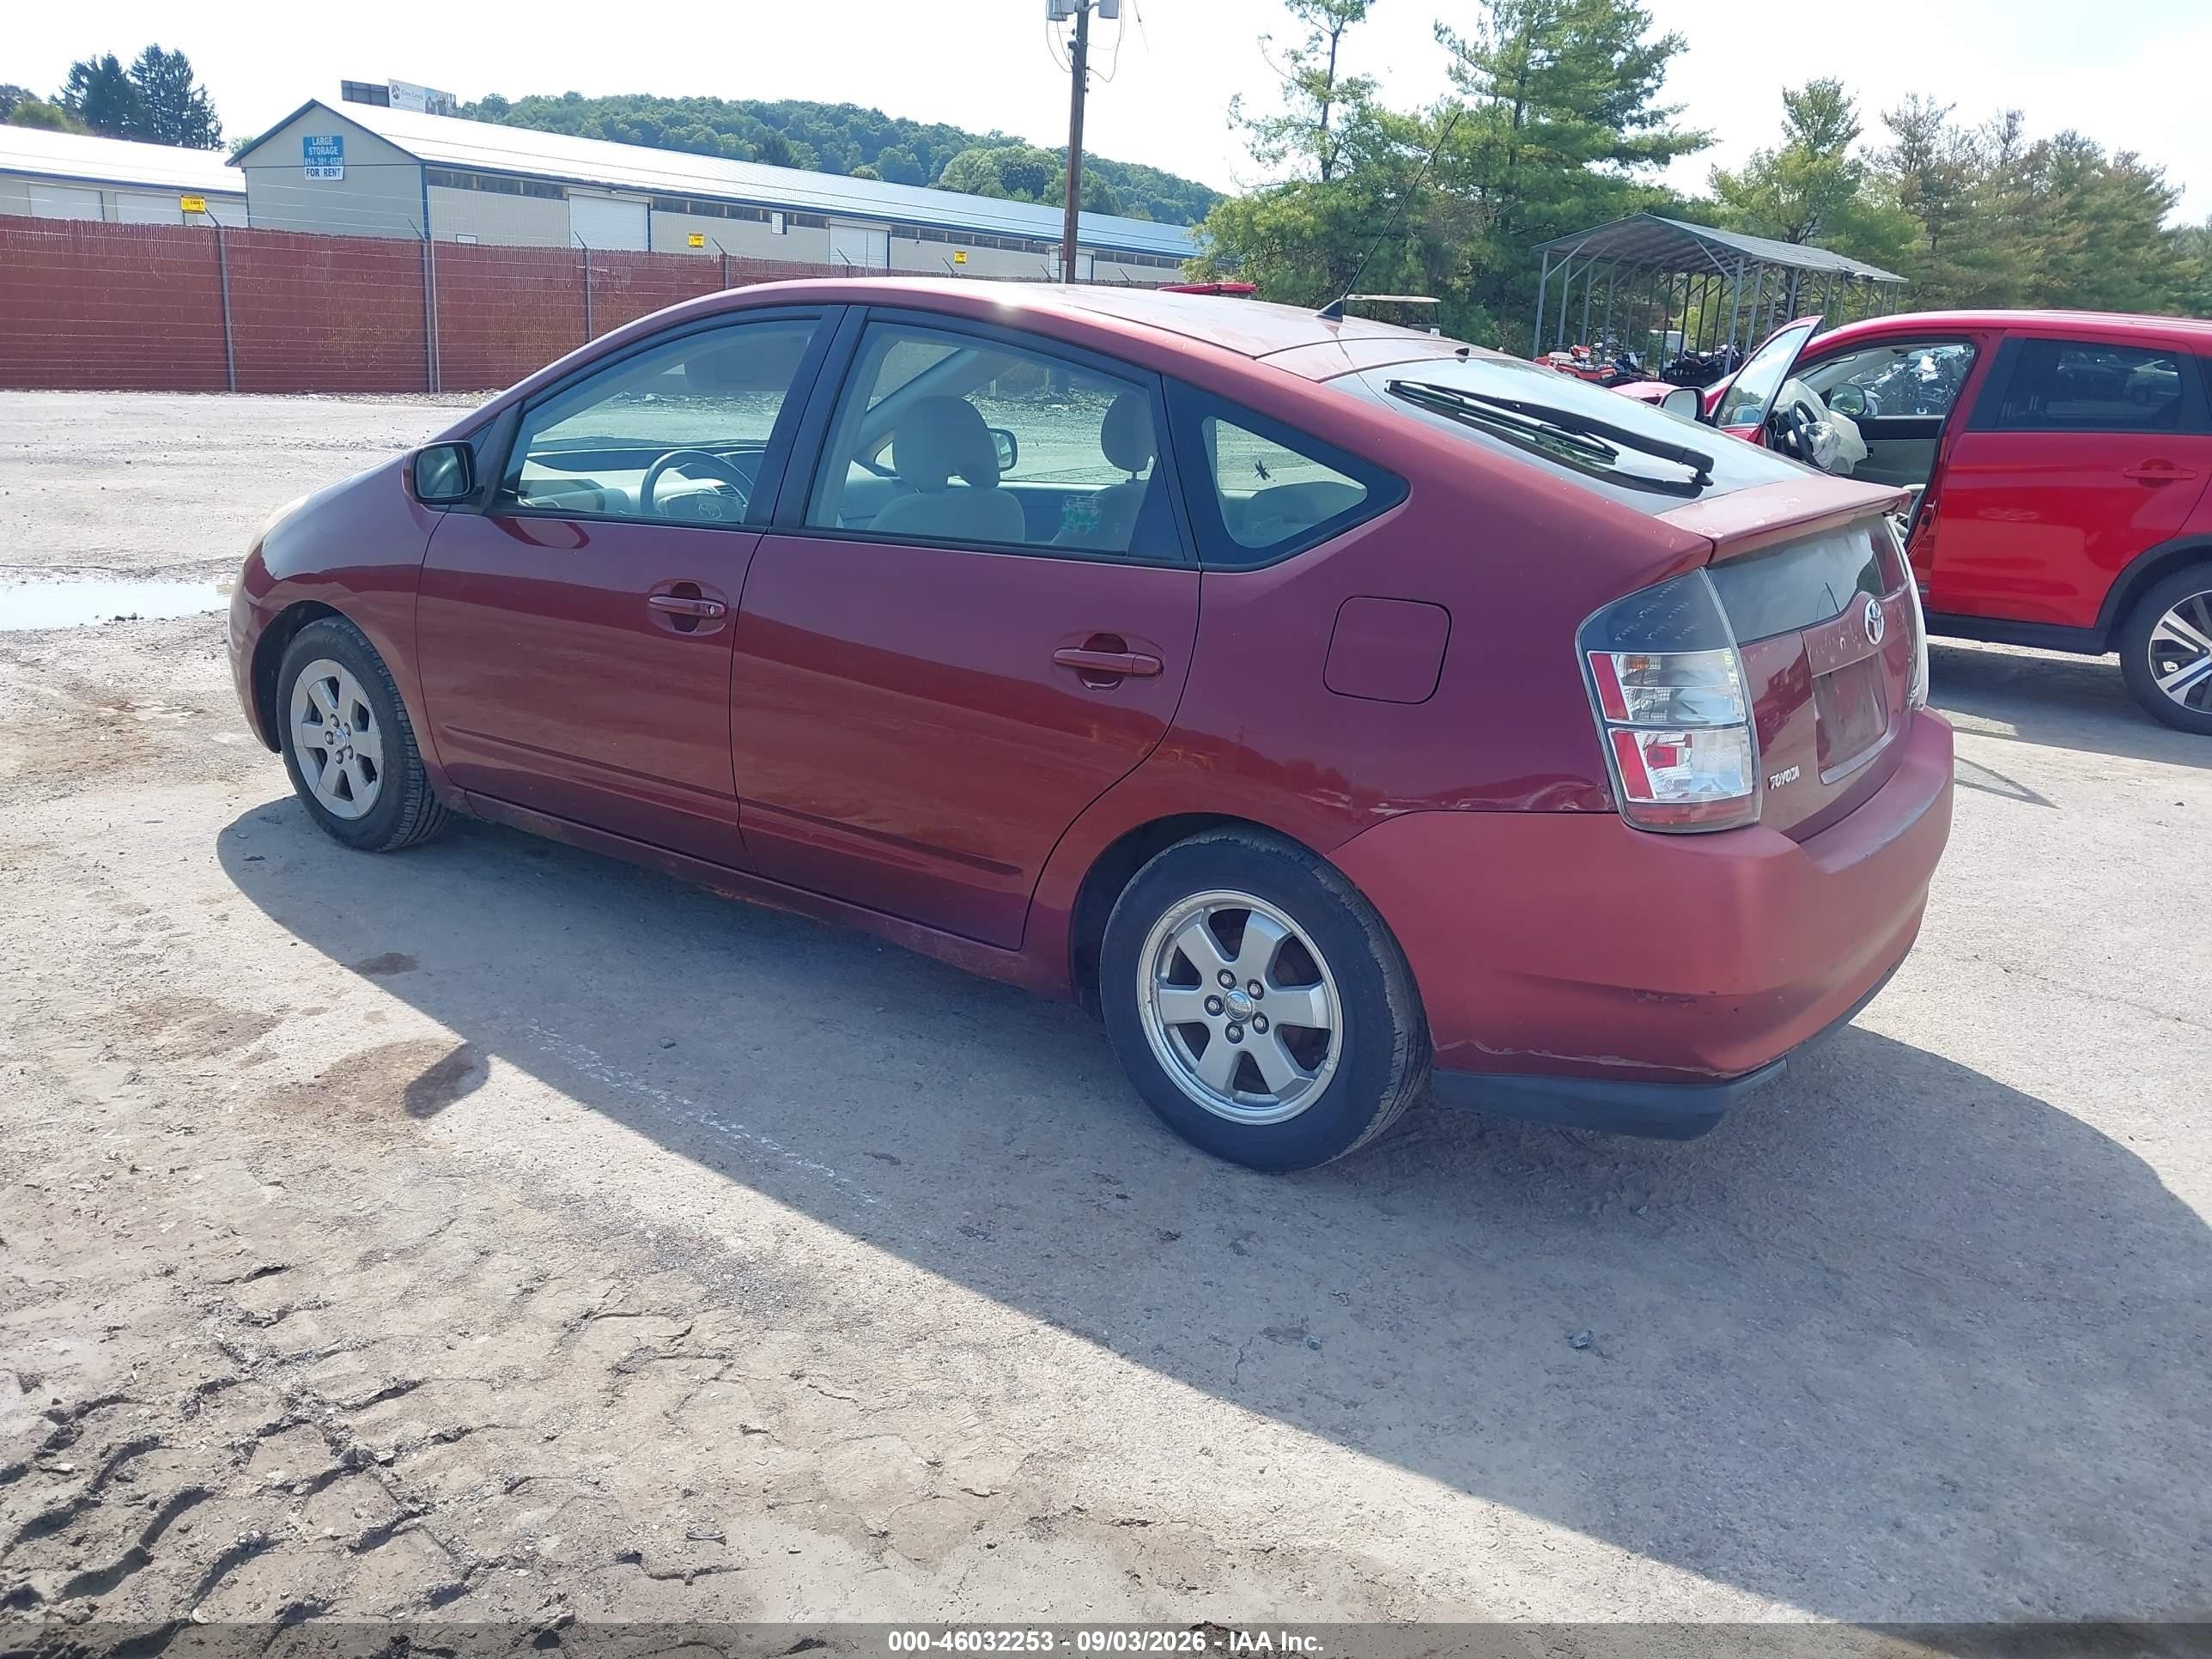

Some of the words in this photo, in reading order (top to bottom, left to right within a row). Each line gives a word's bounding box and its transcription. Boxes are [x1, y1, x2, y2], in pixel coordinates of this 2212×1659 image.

[312, 137, 334, 146] LARGE
[308, 146, 339, 155] STORAGE
[306, 167, 320, 177] FOR
[324, 167, 342, 177] RENT
[1769, 765, 1800, 790] TOYOTA
